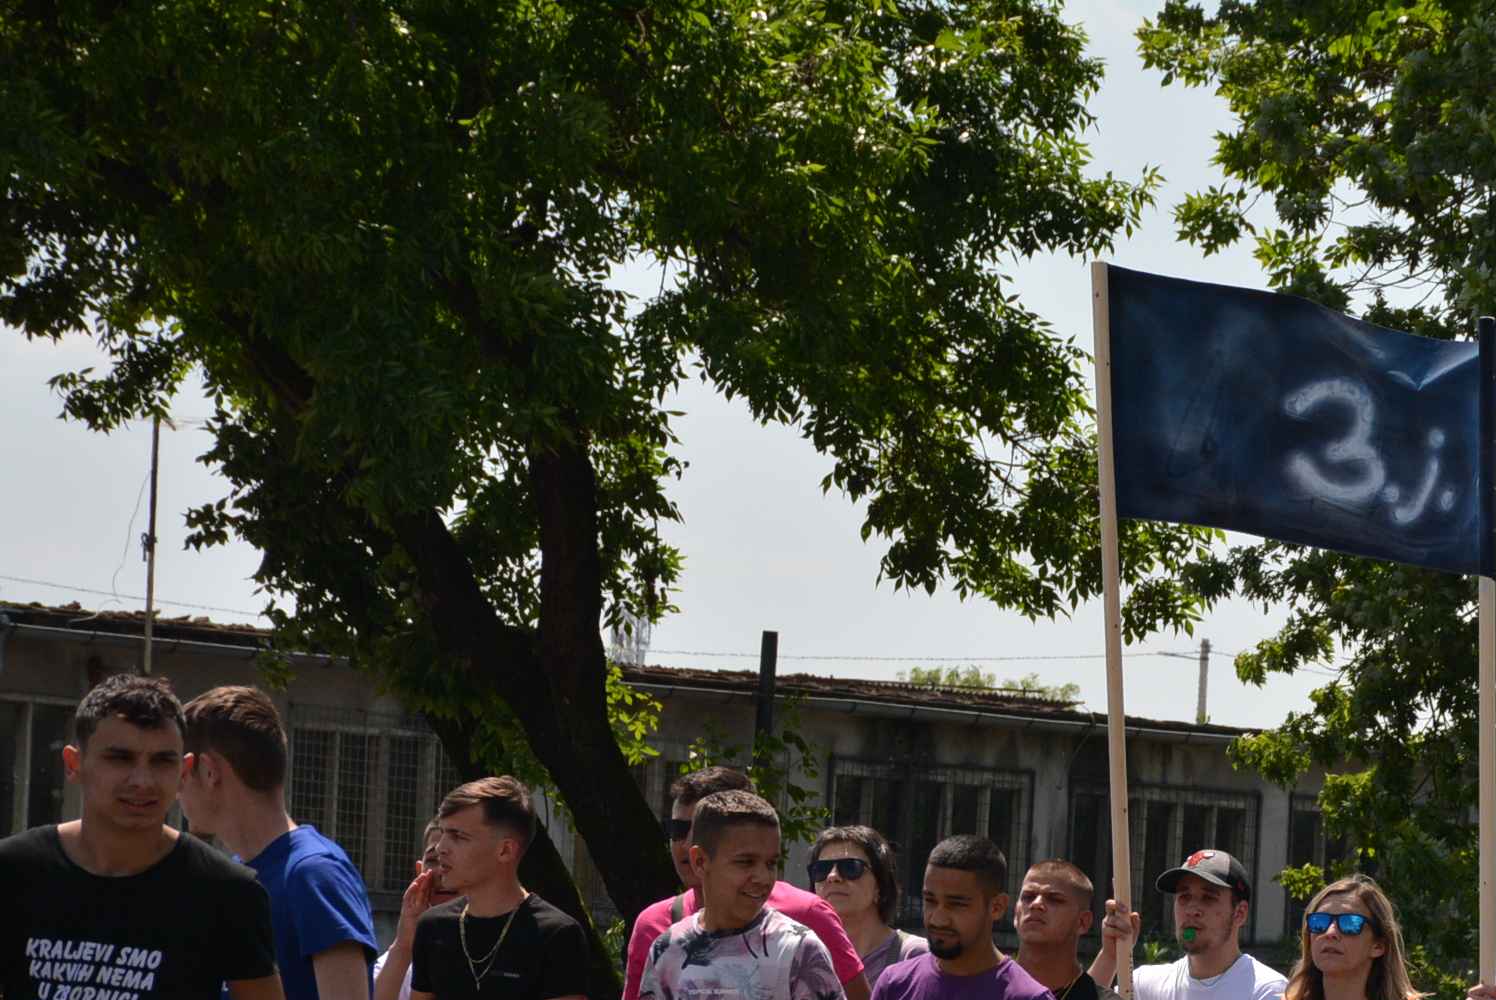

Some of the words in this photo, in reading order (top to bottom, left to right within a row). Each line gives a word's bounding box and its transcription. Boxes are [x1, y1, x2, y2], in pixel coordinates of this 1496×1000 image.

[25, 937, 114, 962] KRALJEVI
[116, 946, 162, 969] SMO
[29, 959, 94, 982] KAKVIH
[96, 966, 155, 991] NEMA
[38, 982, 51, 1000] U
